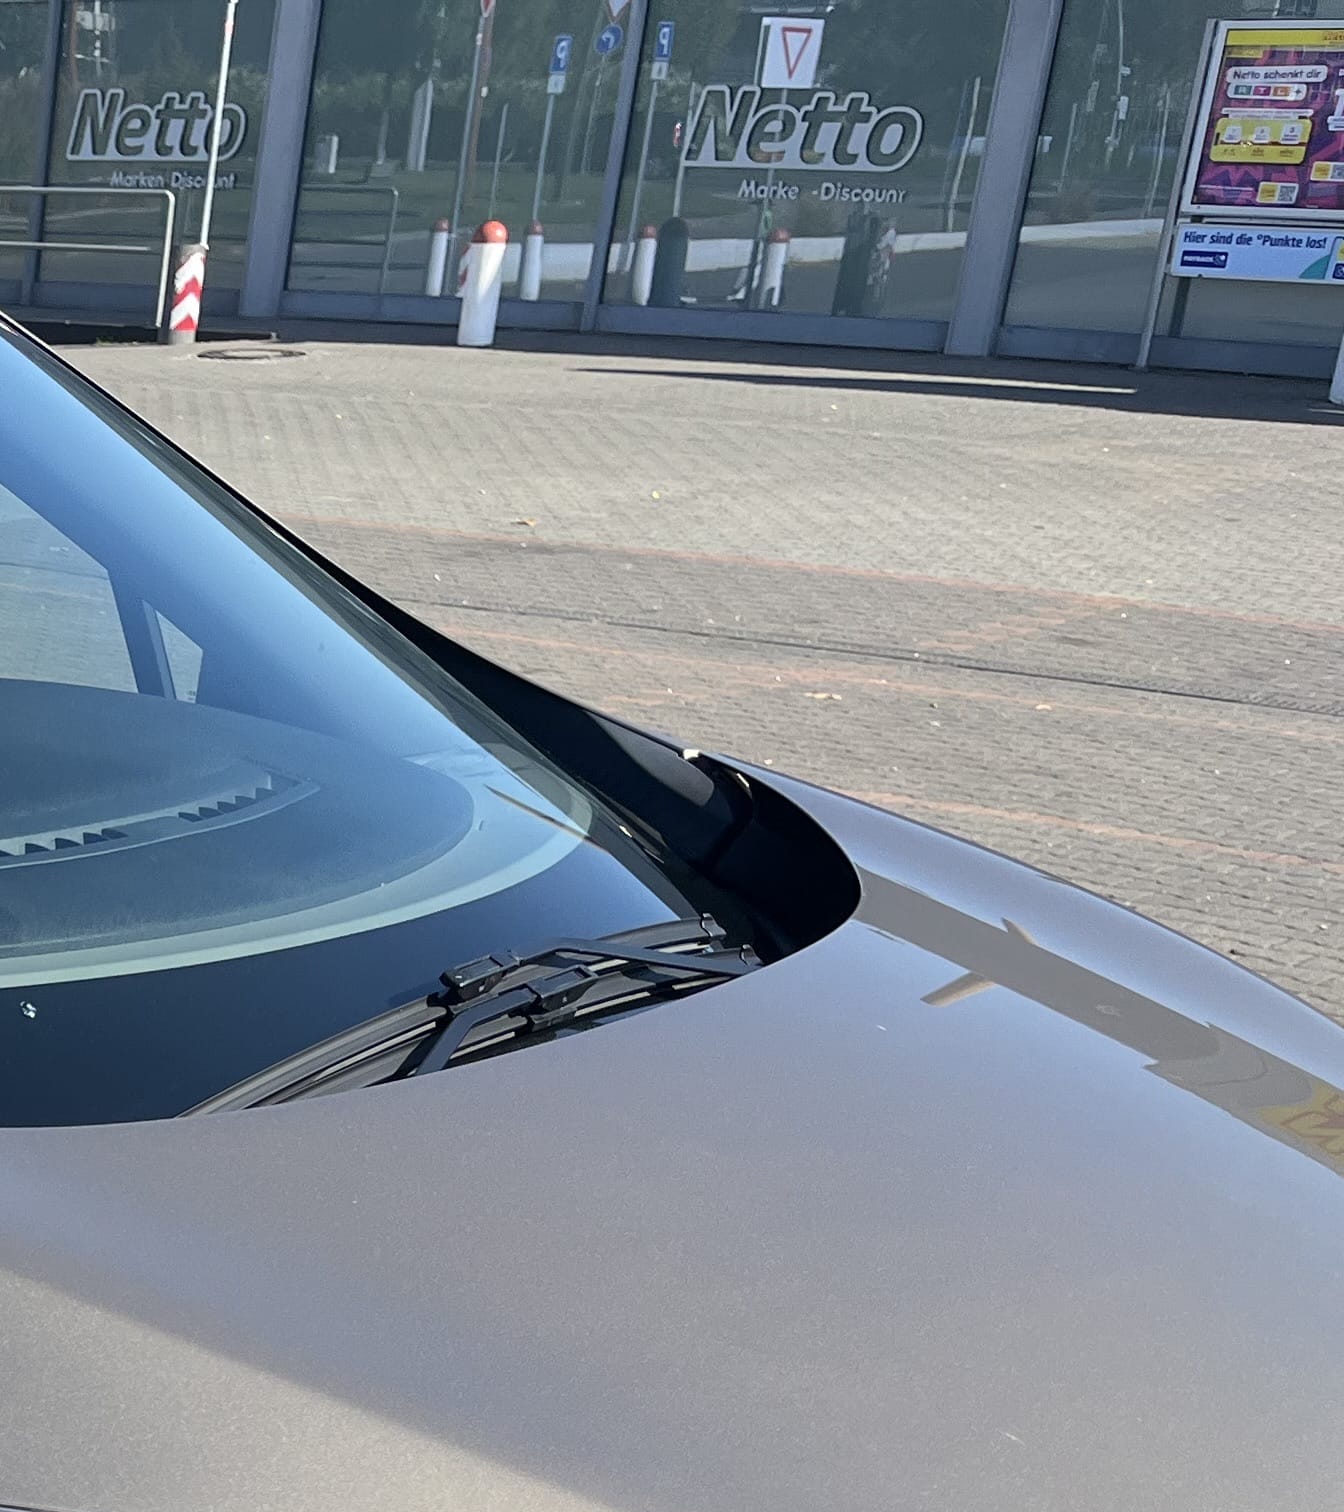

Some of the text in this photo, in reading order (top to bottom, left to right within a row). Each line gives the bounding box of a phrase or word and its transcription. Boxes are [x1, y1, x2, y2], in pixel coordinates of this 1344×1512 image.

[1233, 68, 1322, 80] Netto schenkt dir
[66, 89, 247, 161] Netto
[683, 85, 924, 172] Netto
[1183, 231, 1207, 244] Hier
[1209, 232, 1234, 245] sind
[1236, 233, 1253, 245] die
[1305, 236, 1328, 249] los!
